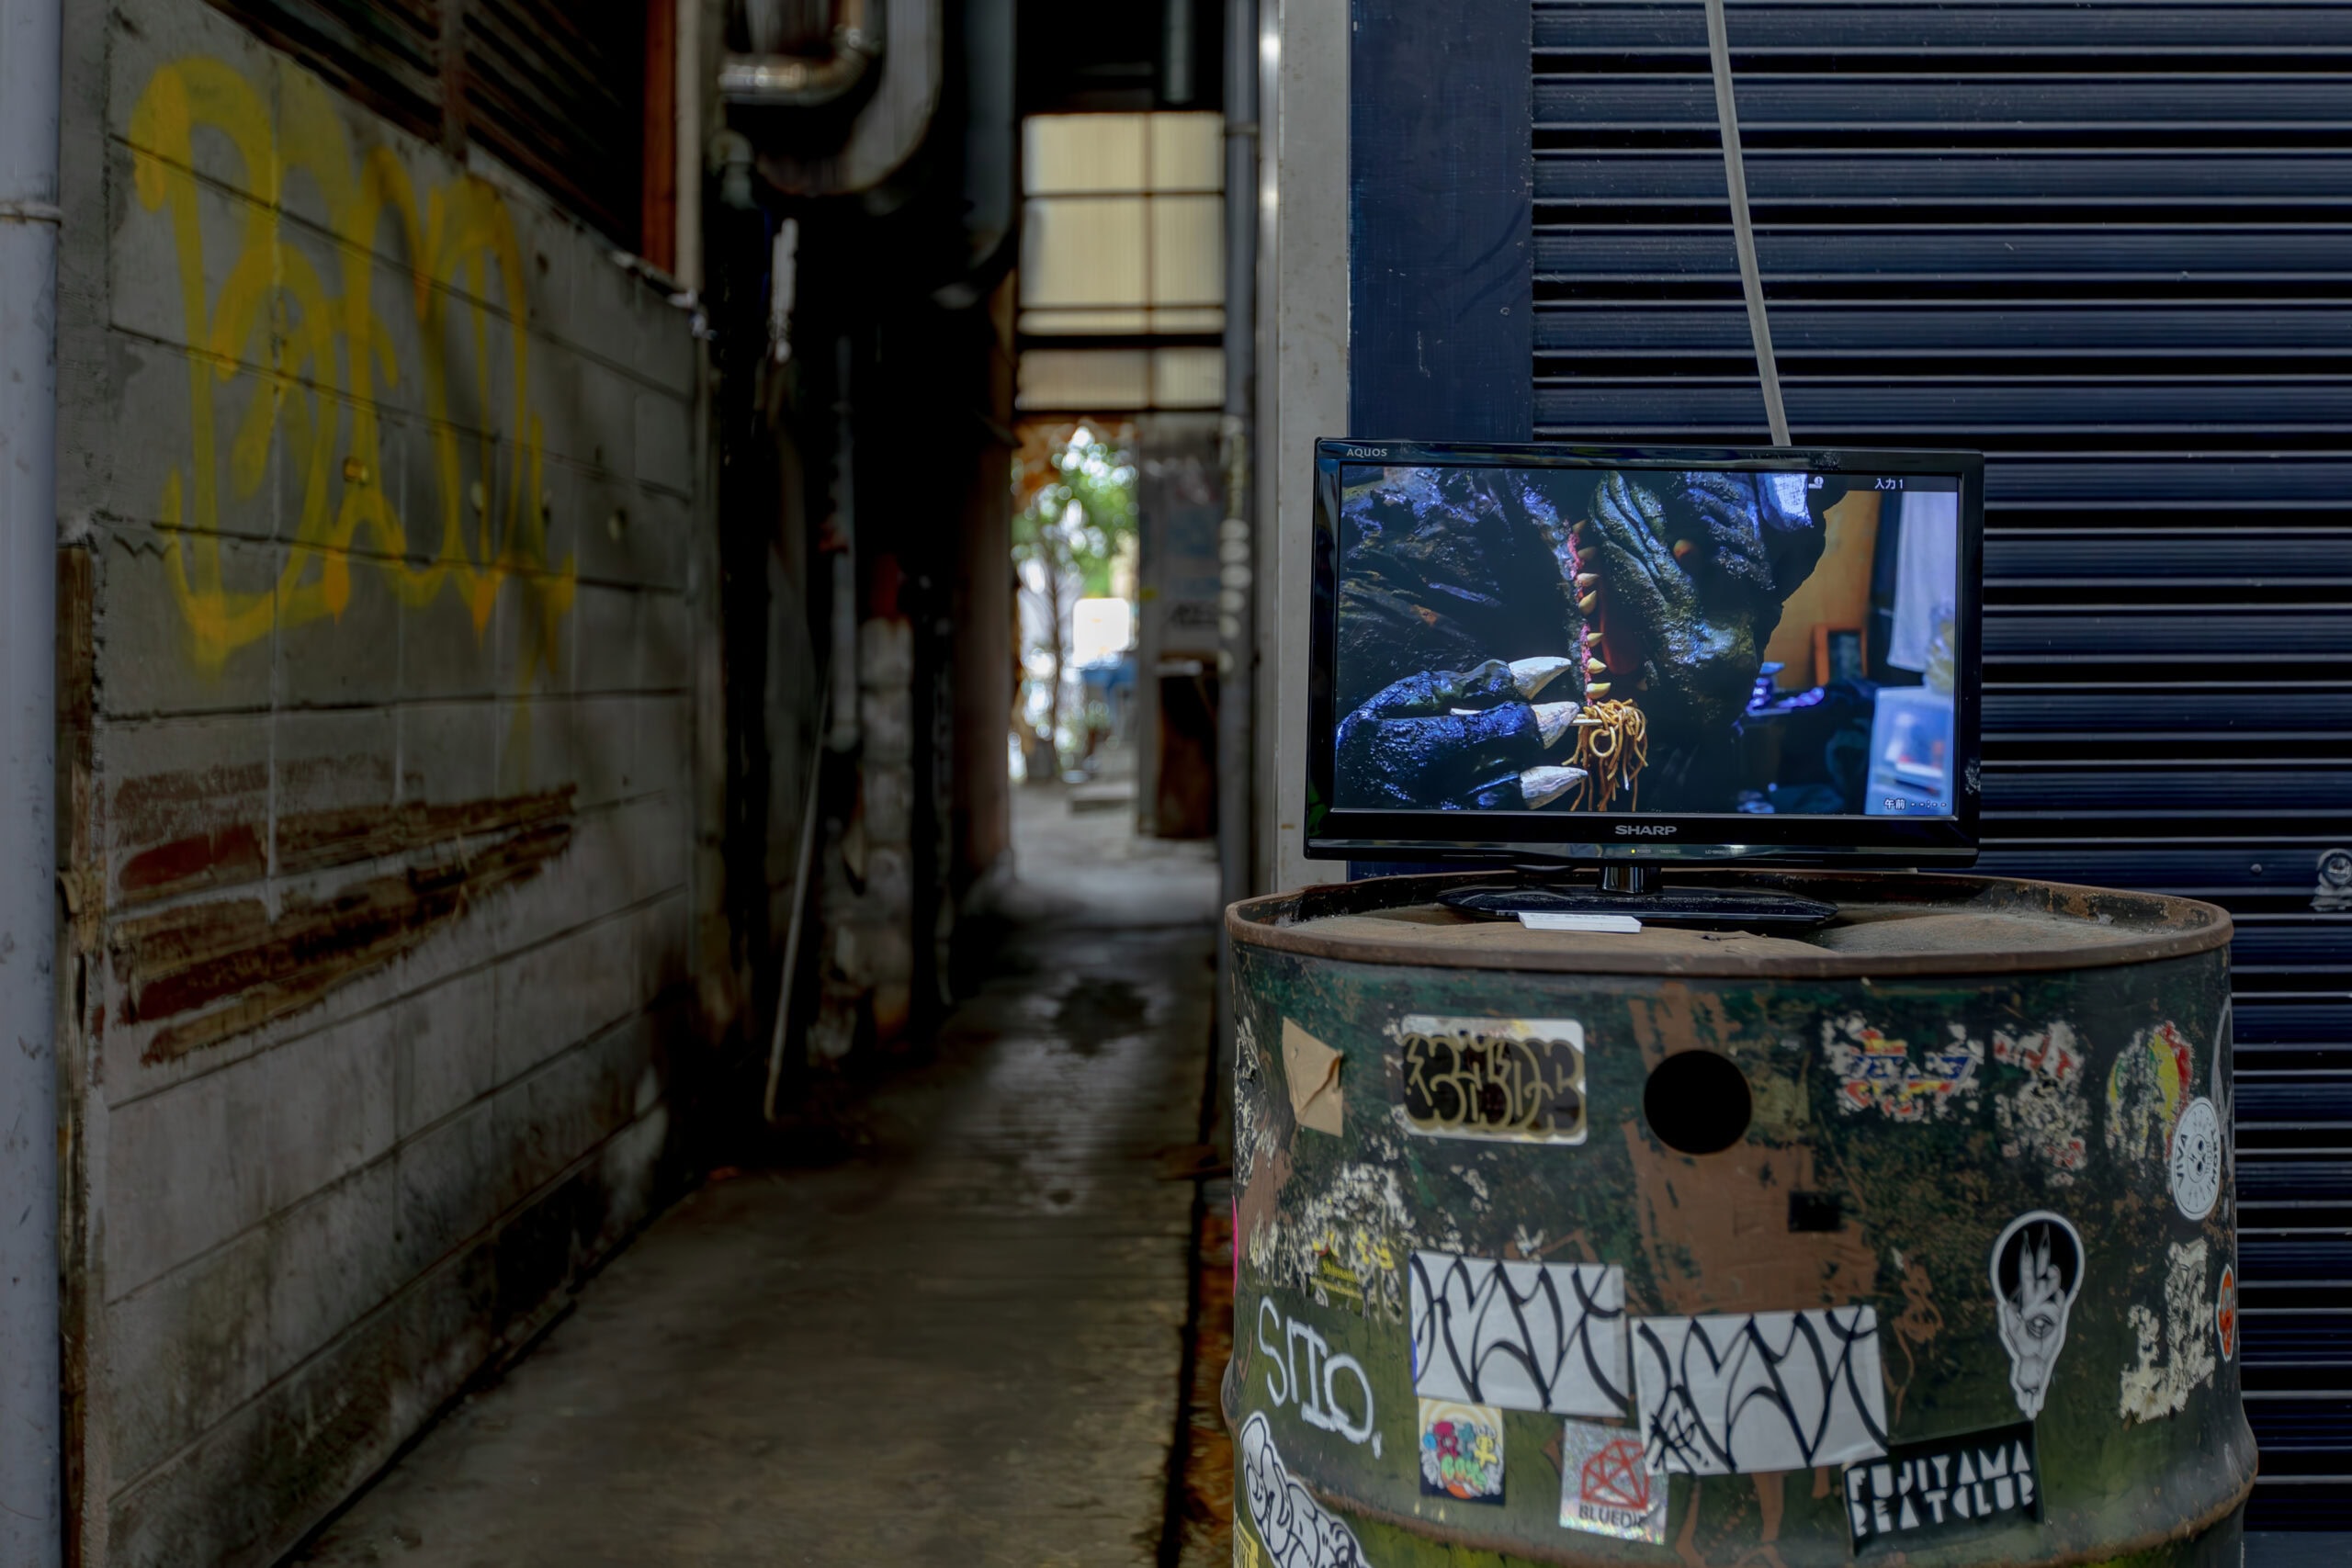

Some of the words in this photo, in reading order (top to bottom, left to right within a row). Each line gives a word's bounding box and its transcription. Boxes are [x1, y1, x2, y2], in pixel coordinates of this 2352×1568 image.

[1346, 447, 1388, 458] AQUOS
[1884, 798, 1905, 809] 午前
[1614, 824, 1678, 836] SHARP
[2176, 1134, 2188, 1190] VIVA
[1847, 1438, 2031, 1501] FUJIYAMA
